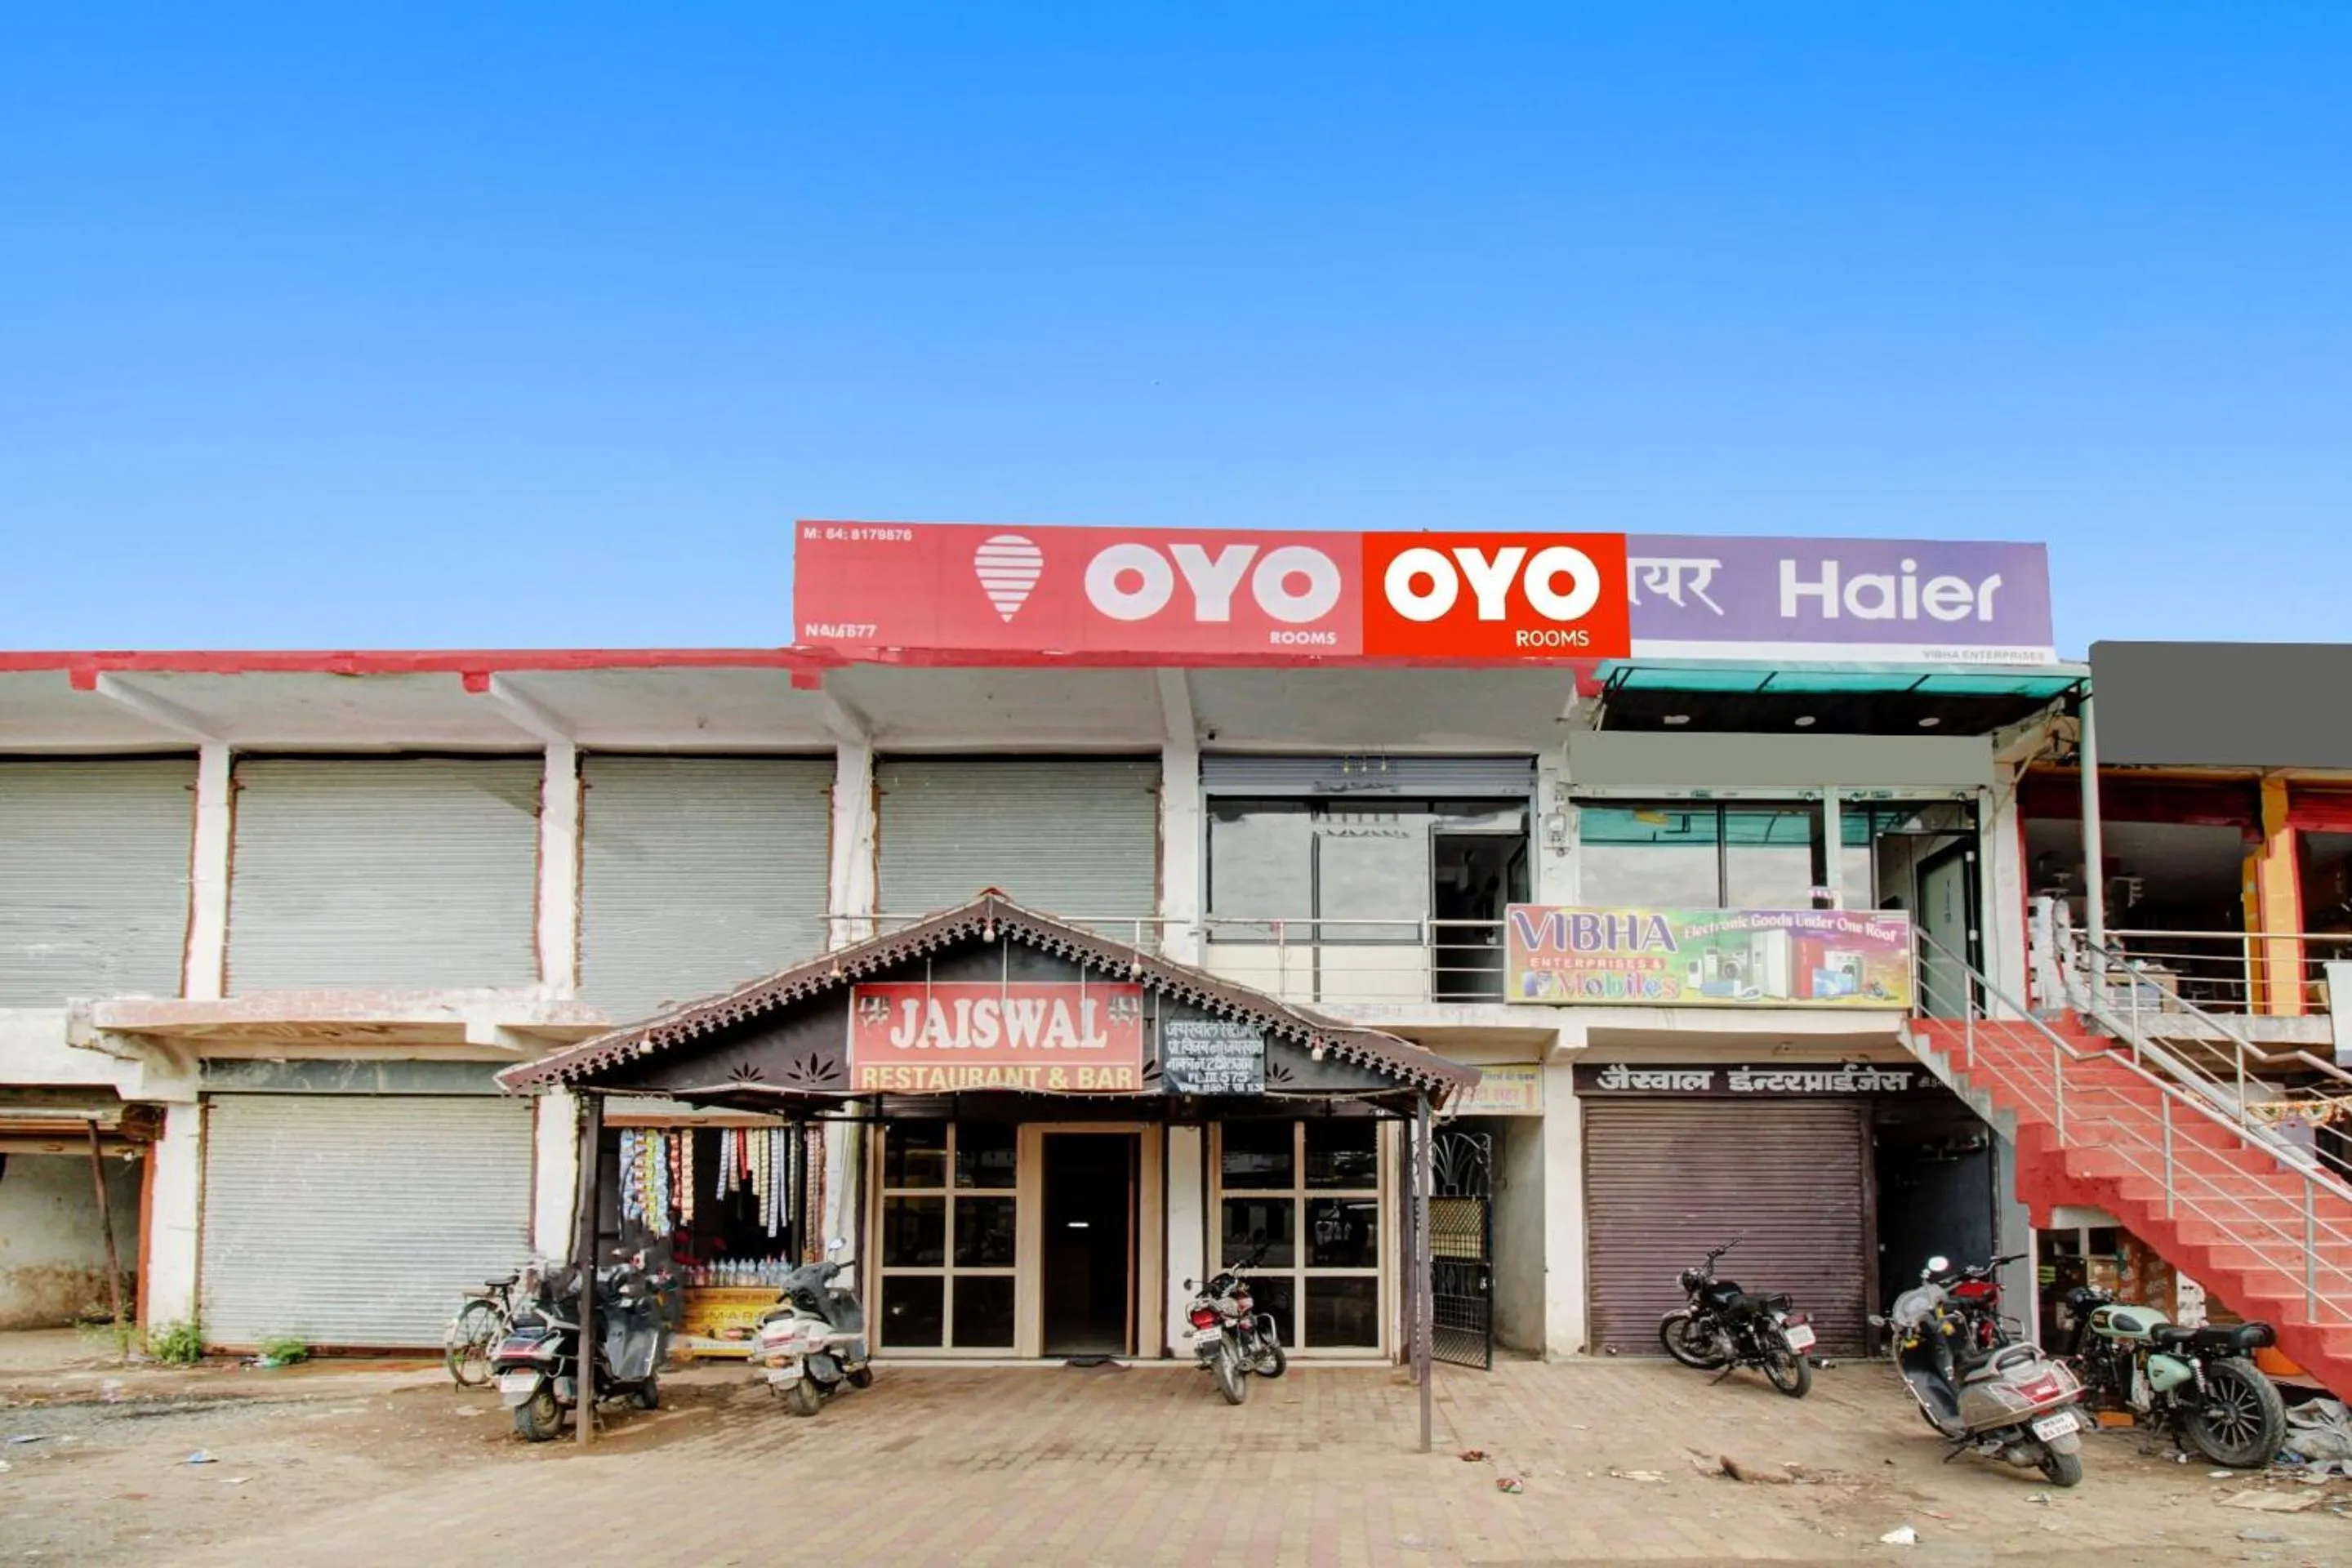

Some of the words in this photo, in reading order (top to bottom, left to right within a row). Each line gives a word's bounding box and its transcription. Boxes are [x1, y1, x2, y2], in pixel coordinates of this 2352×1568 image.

[1084, 542, 1342, 624] OYO
[1384, 545, 1601, 623] OYO
[1627, 558, 1724, 616] ायर
[1780, 557, 2002, 623] Haier
[1269, 631, 1338, 645] ROOMS
[1515, 630, 1590, 648] ROOMS
[1512, 911, 1677, 954] VIBHA
[1684, 916, 1748, 938] Electronic
[1751, 913, 1793, 928] Goods
[1796, 914, 1834, 929] Under
[1838, 917, 1864, 933] One
[1865, 922, 1896, 942] Roof
[1530, 958, 1646, 969] ENTERPRISES
[1557, 970, 1680, 999] Mobiles
[890, 996, 1107, 1049] JAISWAL
[862, 1065, 1041, 1089] RESTAURANT
[1049, 1066, 1068, 1089] &
[1076, 1066, 1133, 1089] BAR
